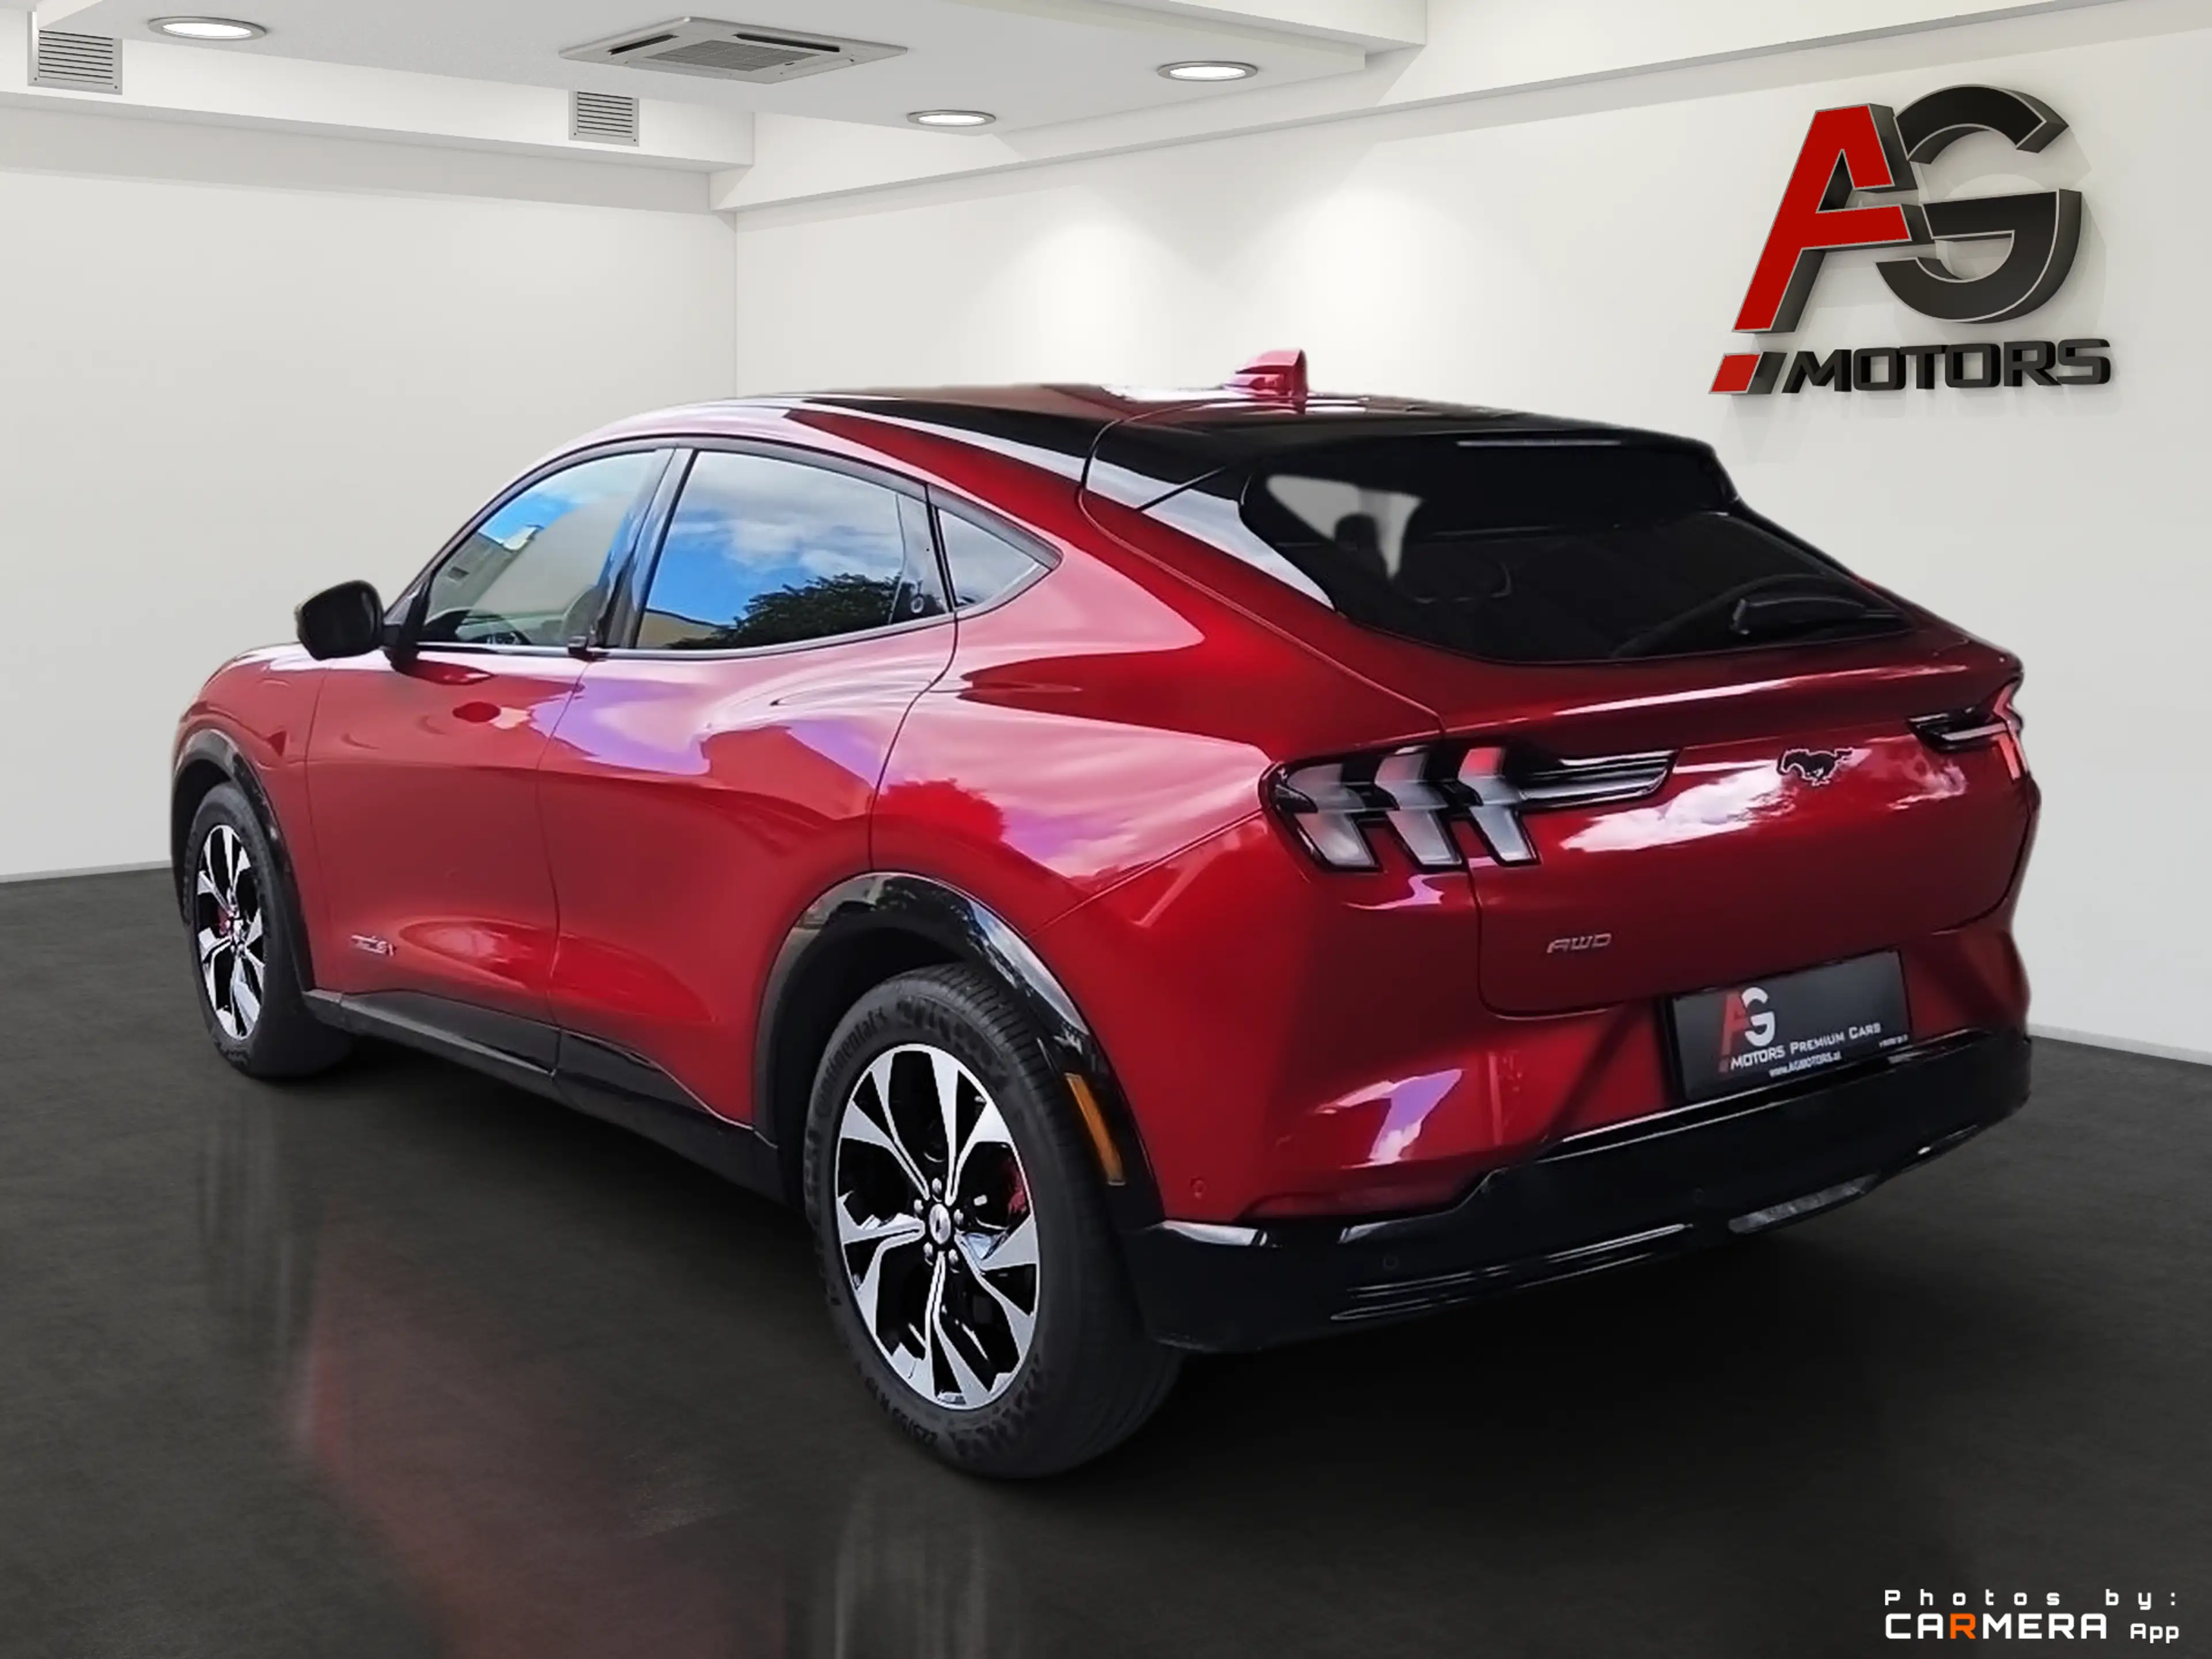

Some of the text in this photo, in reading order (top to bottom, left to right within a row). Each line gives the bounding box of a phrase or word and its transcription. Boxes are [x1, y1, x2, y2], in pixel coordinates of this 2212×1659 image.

[1731, 84, 2082, 333] AG
[1781, 338, 2111, 393] MOTORS
[1546, 933, 1612, 954] AWD
[1721, 987, 1775, 1056] AG
[1730, 1044, 1785, 1070] MOTORS
